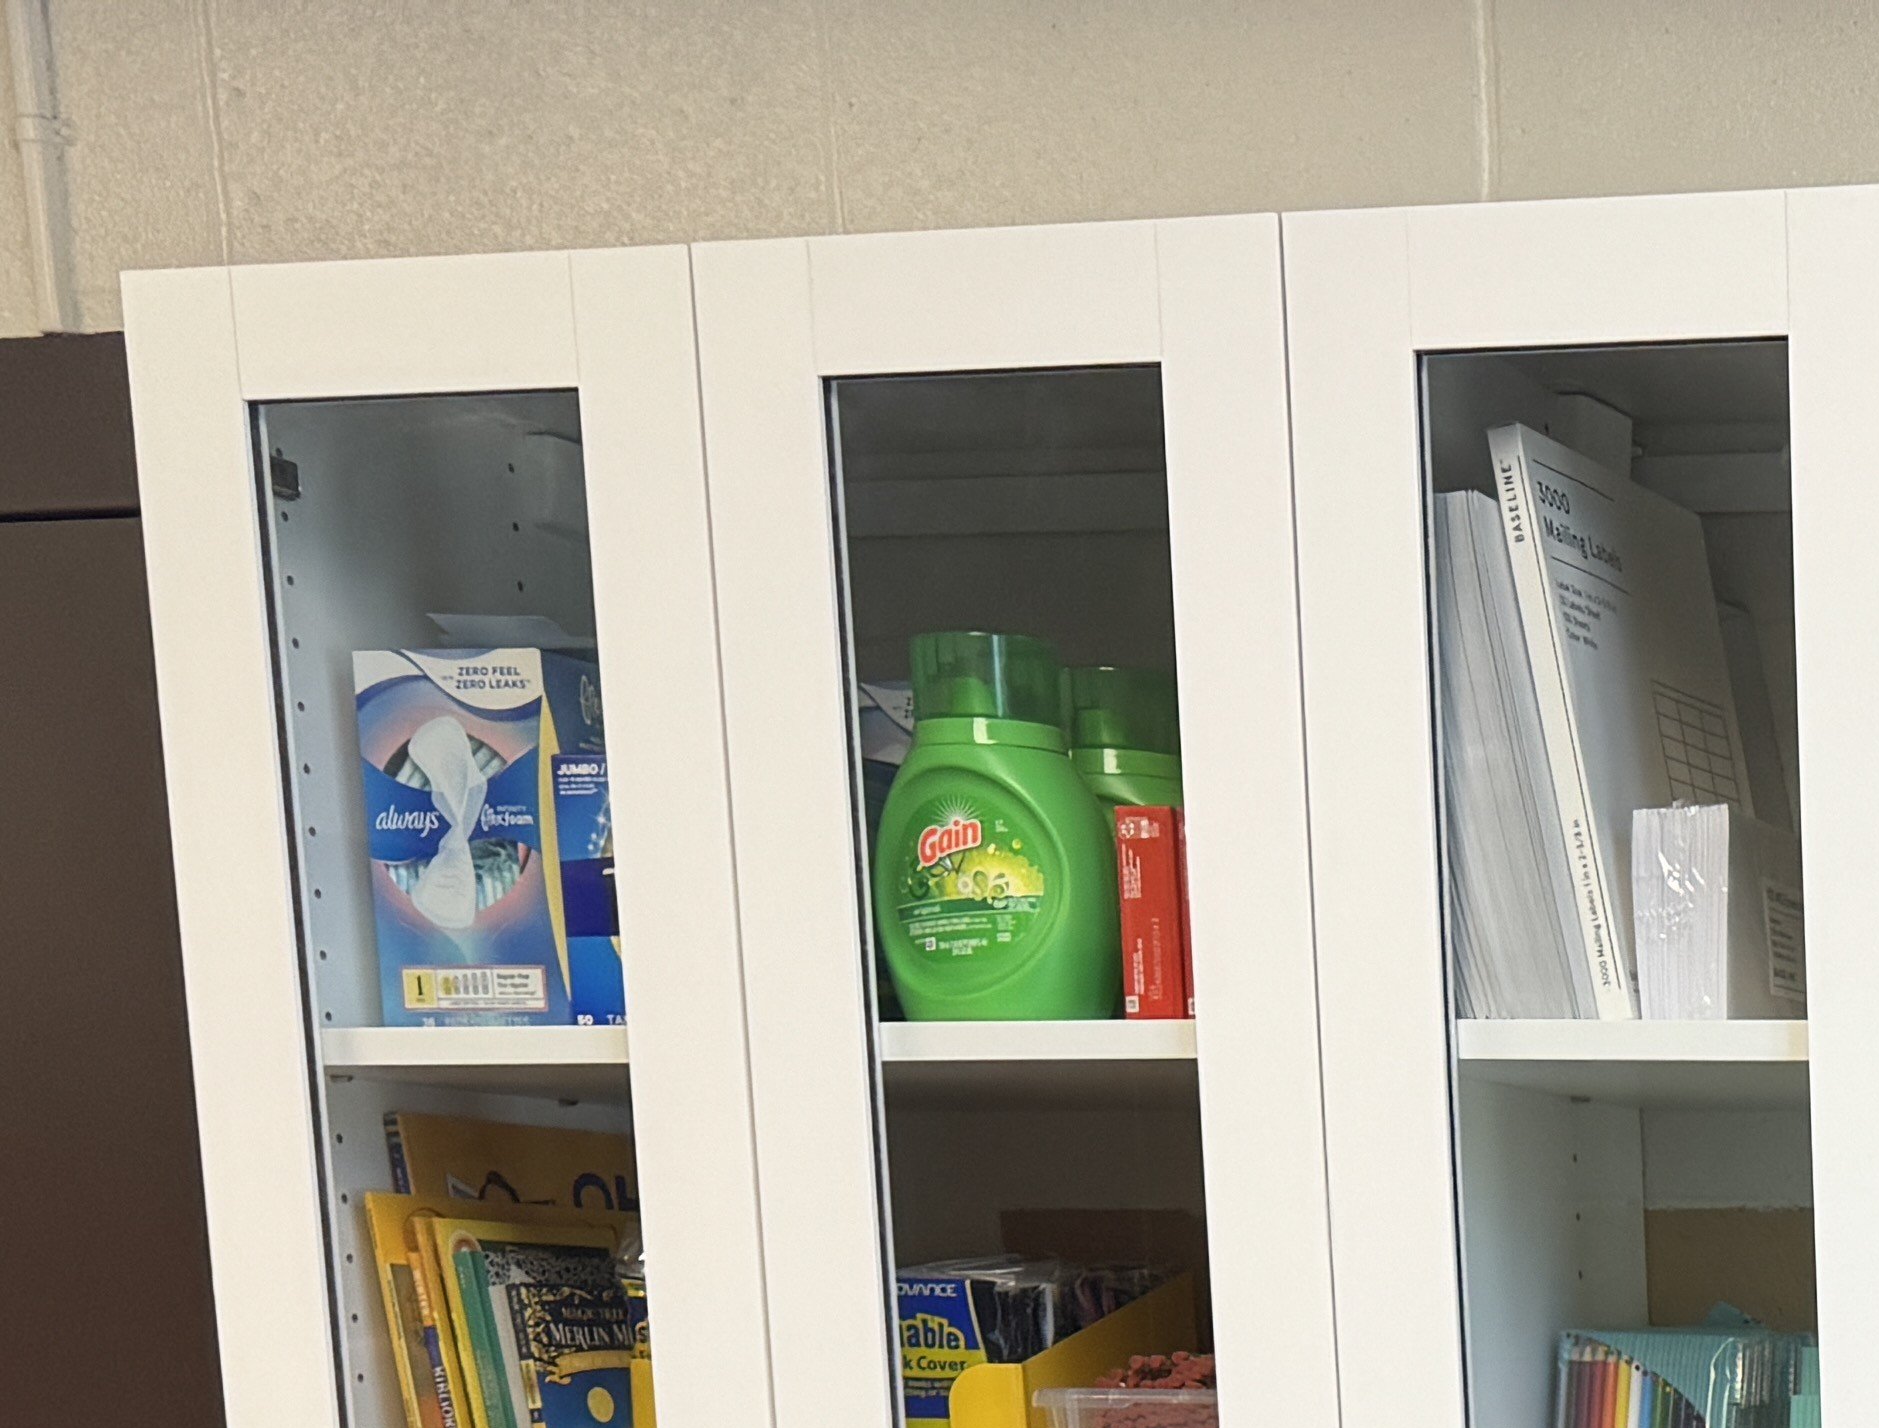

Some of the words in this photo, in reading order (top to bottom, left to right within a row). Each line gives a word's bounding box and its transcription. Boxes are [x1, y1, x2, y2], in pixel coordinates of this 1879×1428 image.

[1500, 464, 1525, 543] BASELINE
[1537, 480, 1570, 515] 3000
[1543, 515, 1588, 560] Mailing
[1588, 534, 1622, 573] Labels
[456, 679, 486, 690] ZERO
[457, 666, 488, 677] ZERO
[492, 667, 521, 677] FEEL
[557, 763, 599, 775] JUMBO
[376, 804, 440, 838] always
[919, 818, 981, 866] Gain
[416, 974, 423, 996] 1
[549, 1323, 610, 1350] MERLIN
[900, 1318, 961, 1350] able
[917, 1356, 967, 1372] Cover
